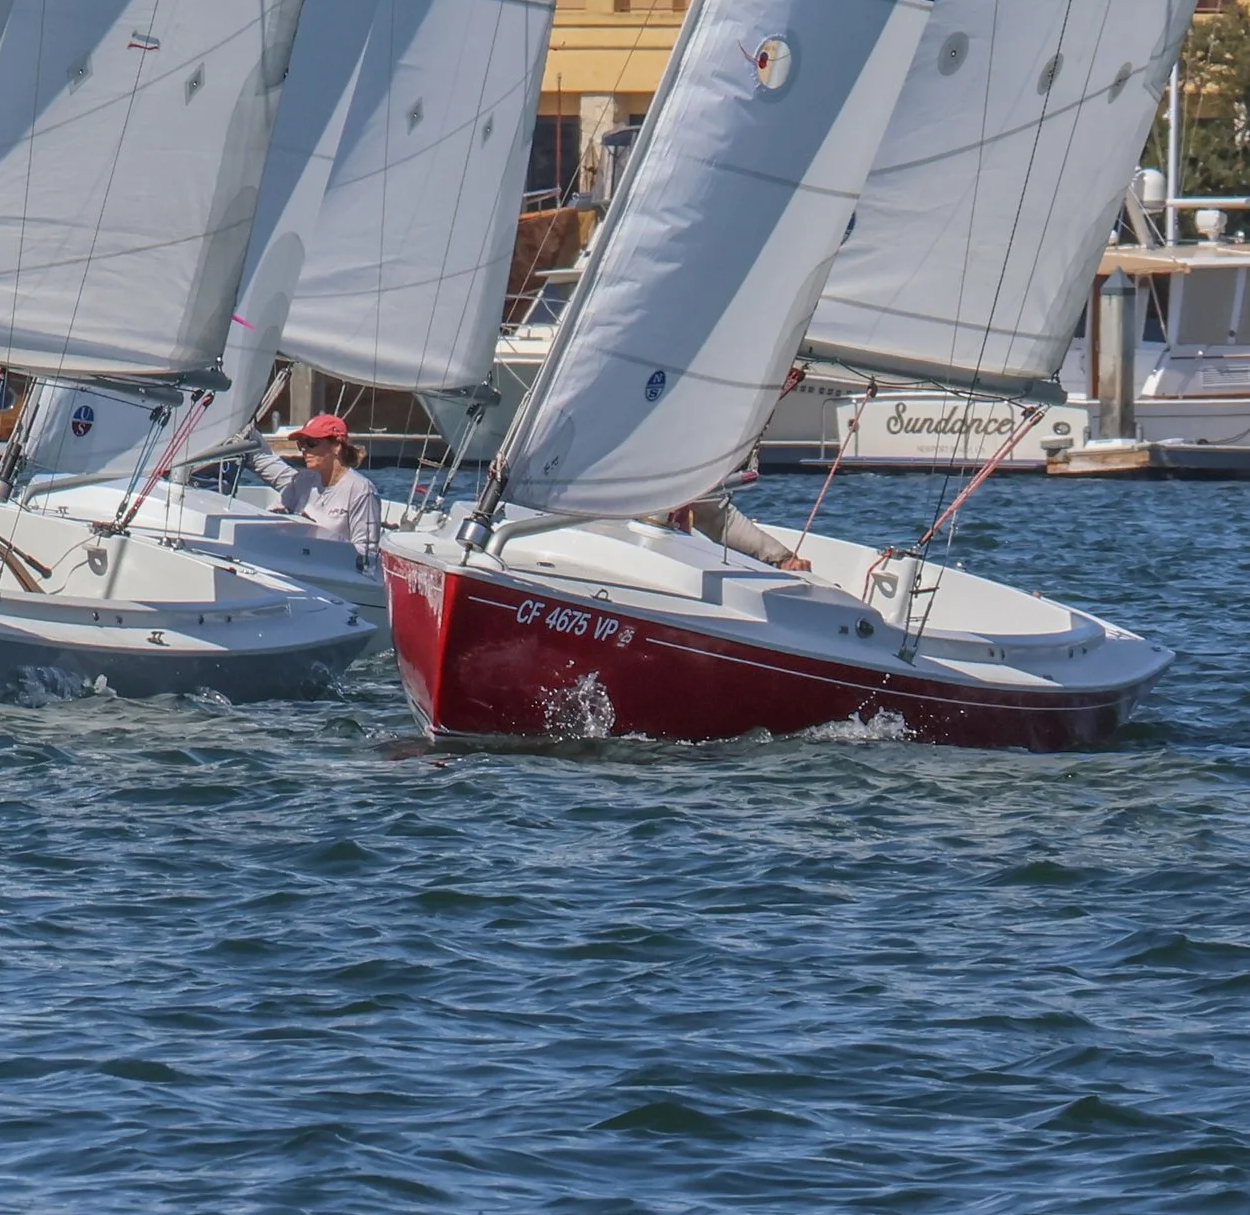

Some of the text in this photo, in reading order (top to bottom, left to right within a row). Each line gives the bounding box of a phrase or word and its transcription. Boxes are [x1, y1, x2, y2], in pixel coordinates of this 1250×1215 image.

[886, 402, 1016, 435] Sundance
[516, 600, 619, 641] CF 4675 VP
